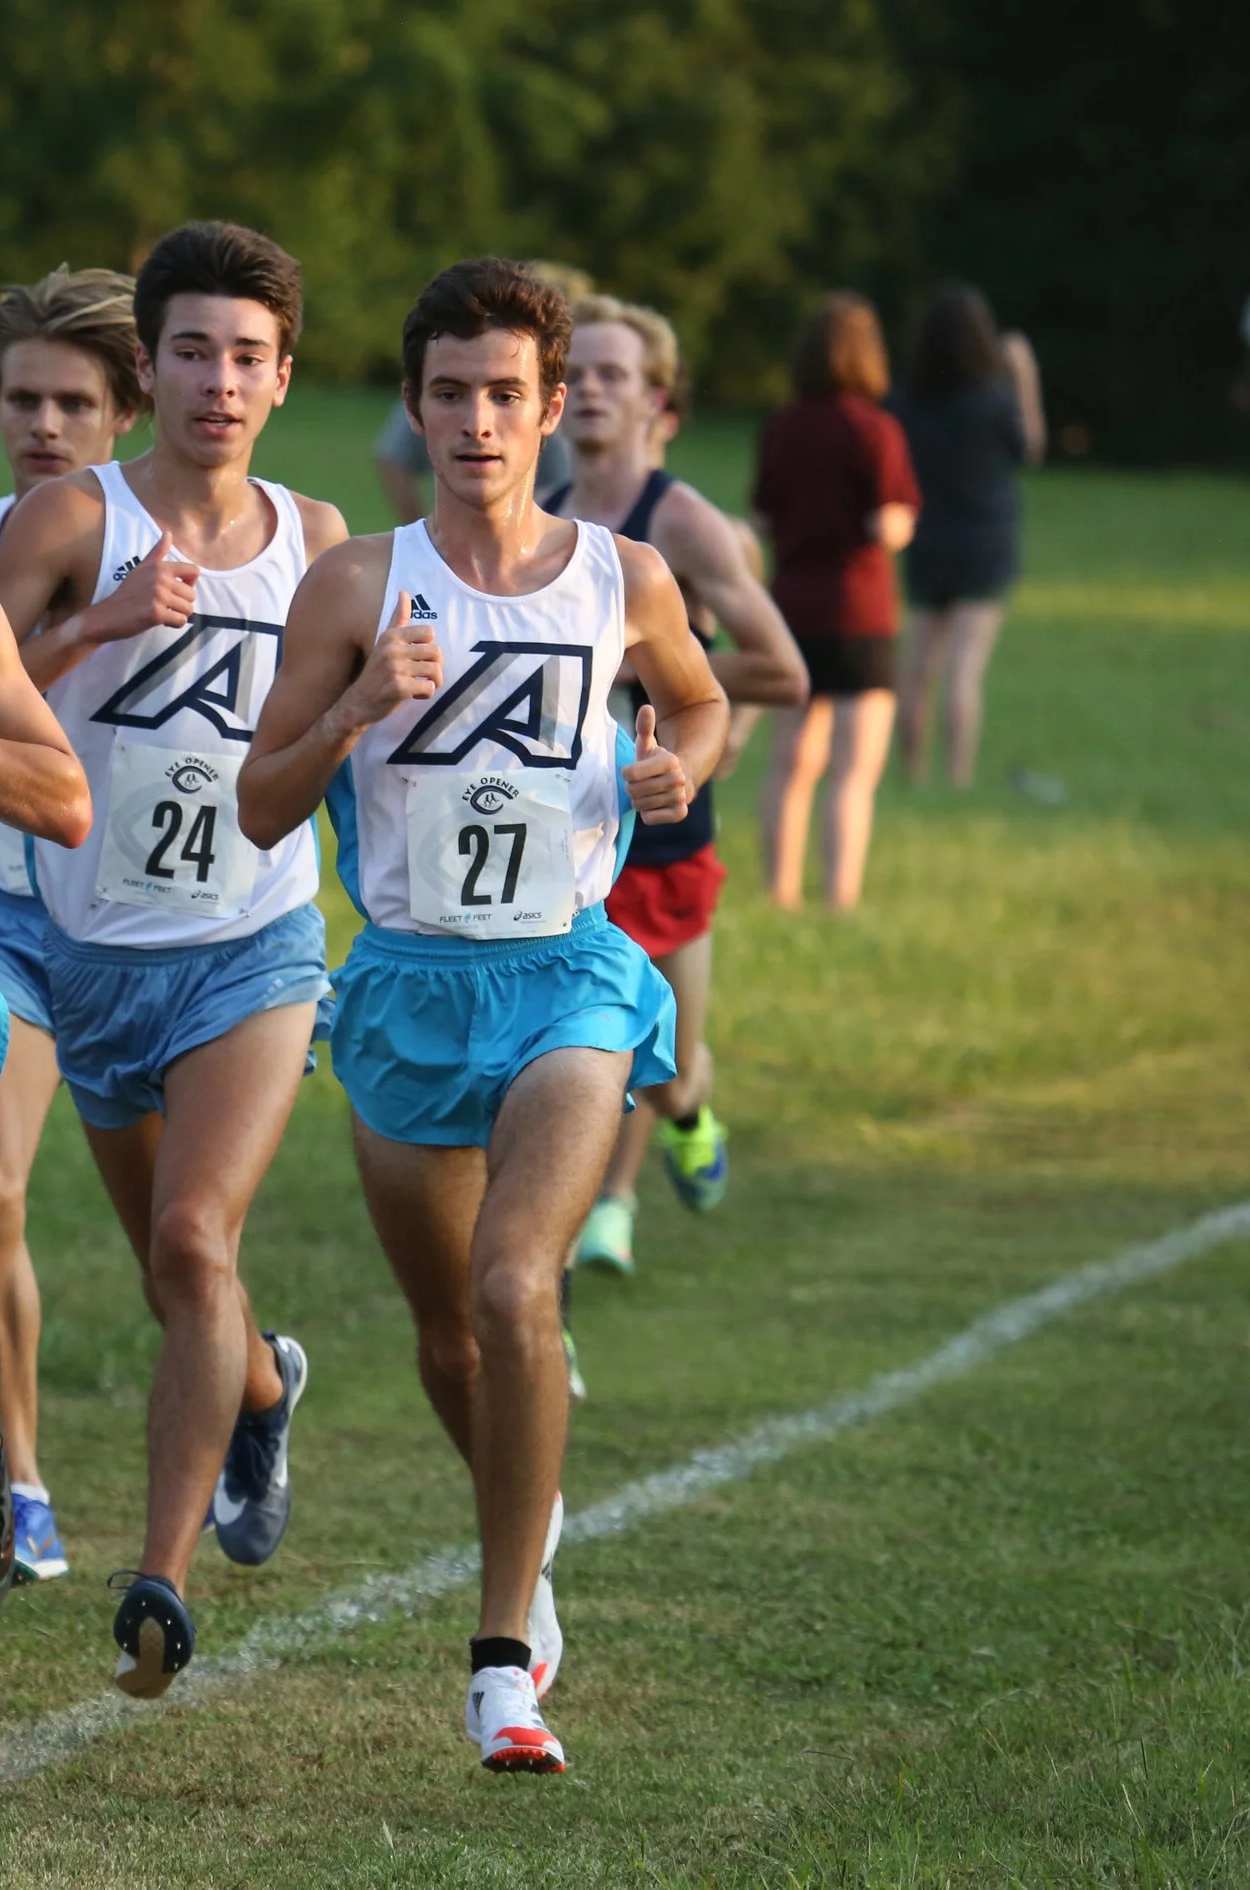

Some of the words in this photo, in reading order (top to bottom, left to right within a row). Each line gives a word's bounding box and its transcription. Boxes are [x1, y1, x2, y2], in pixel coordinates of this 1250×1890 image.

[410, 610, 438, 620] idas
[165, 762, 180, 778] EYE
[185, 757, 219, 780] OPENER
[461, 784, 477, 802] EYE
[480, 777, 520, 798] OPENER
[145, 800, 217, 883] 24
[458, 823, 527, 906] 27
[440, 915, 462, 924] FLEET
[473, 913, 493, 922] FEET
